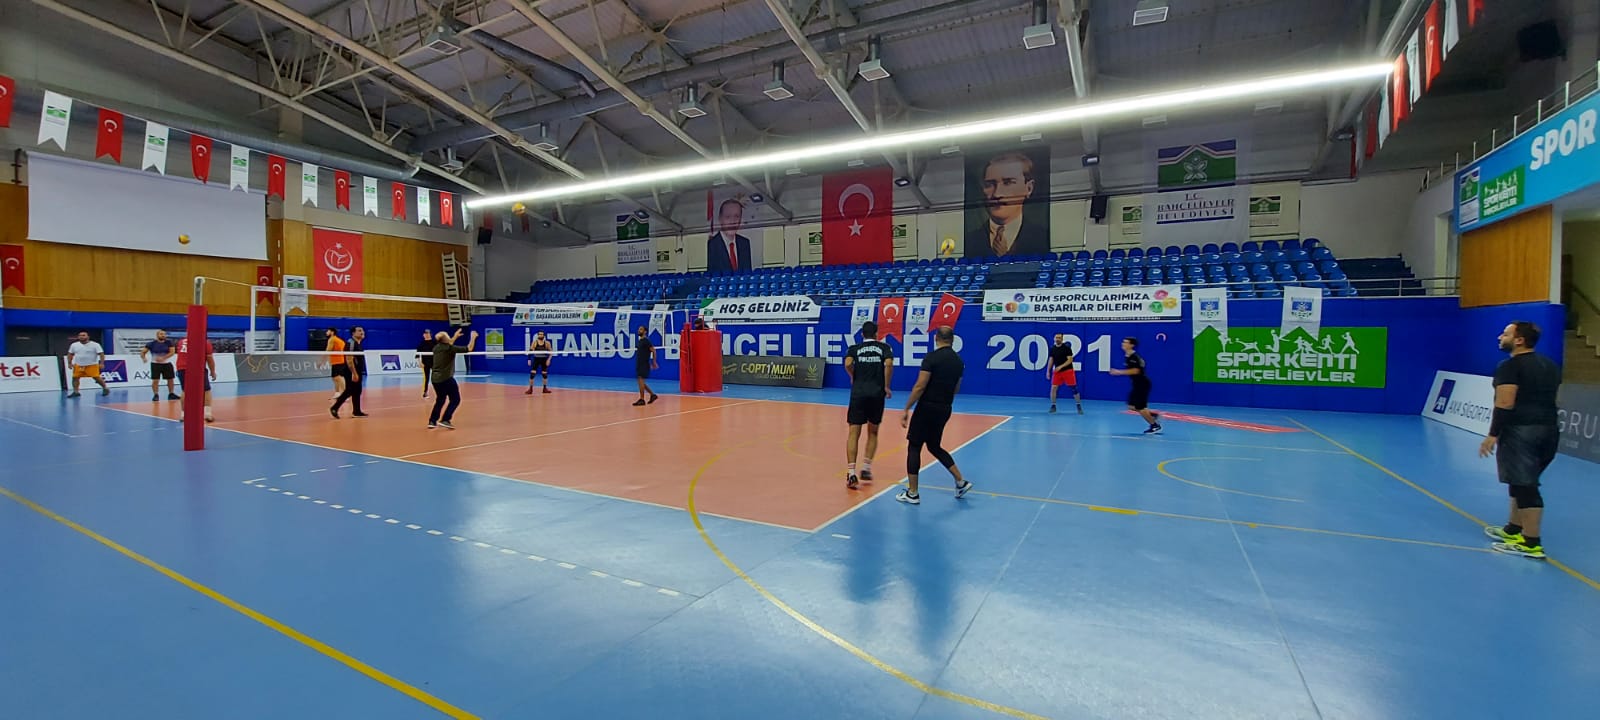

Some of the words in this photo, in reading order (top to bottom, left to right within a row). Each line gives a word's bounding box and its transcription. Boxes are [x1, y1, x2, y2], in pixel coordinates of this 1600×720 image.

[1530, 109, 1597, 171] SPOR
[327, 273, 351, 285] TVF
[1029, 294, 1052, 303] TÜM
[1053, 293, 1150, 303] SPORCULARIMIZA
[719, 303, 746, 315] HOŞ
[748, 300, 811, 313] GELDİNİZ
[1034, 302, 1095, 313] BAŞARILAR
[1097, 301, 1143, 312] DİLERİM
[1217, 352, 1280, 368] SPOR
